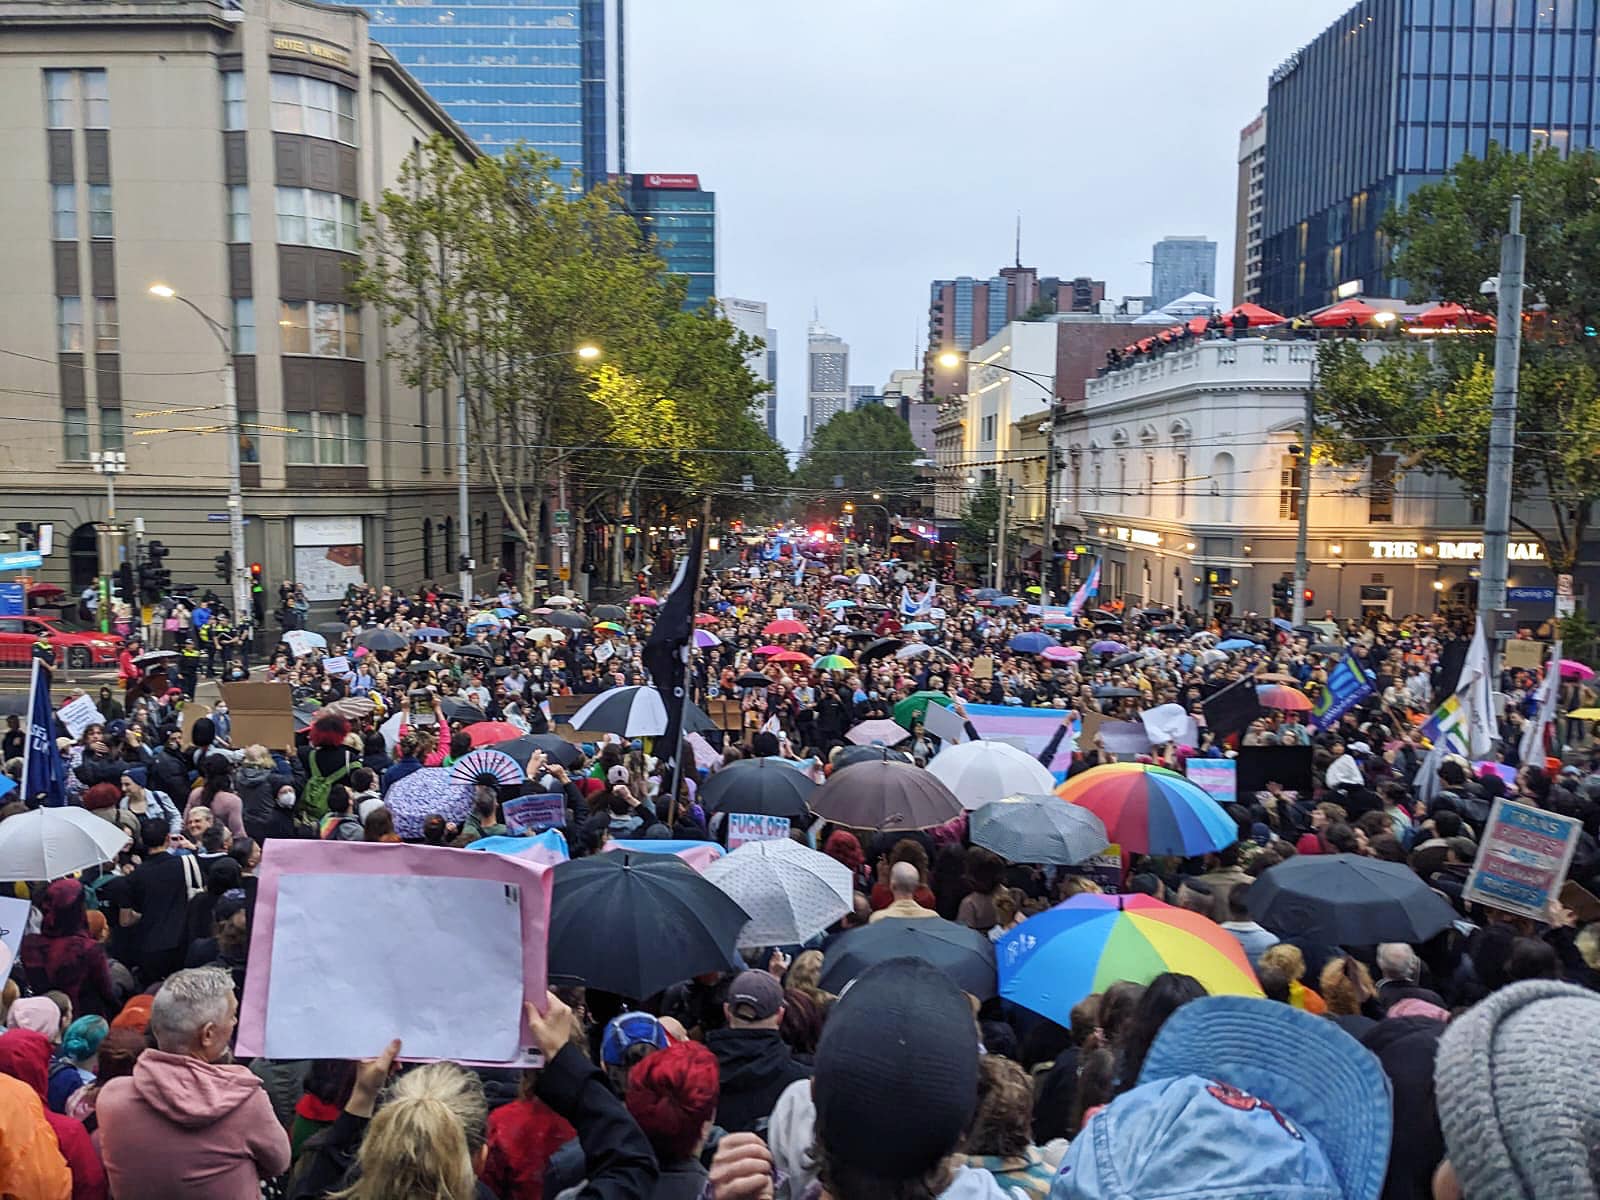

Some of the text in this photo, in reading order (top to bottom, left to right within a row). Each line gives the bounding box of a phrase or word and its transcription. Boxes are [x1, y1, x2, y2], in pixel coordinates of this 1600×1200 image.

[1368, 541, 1545, 560] THE IMPIAL
[730, 813, 788, 836] FUCK OFF
[1510, 809, 1560, 834] TRANS
